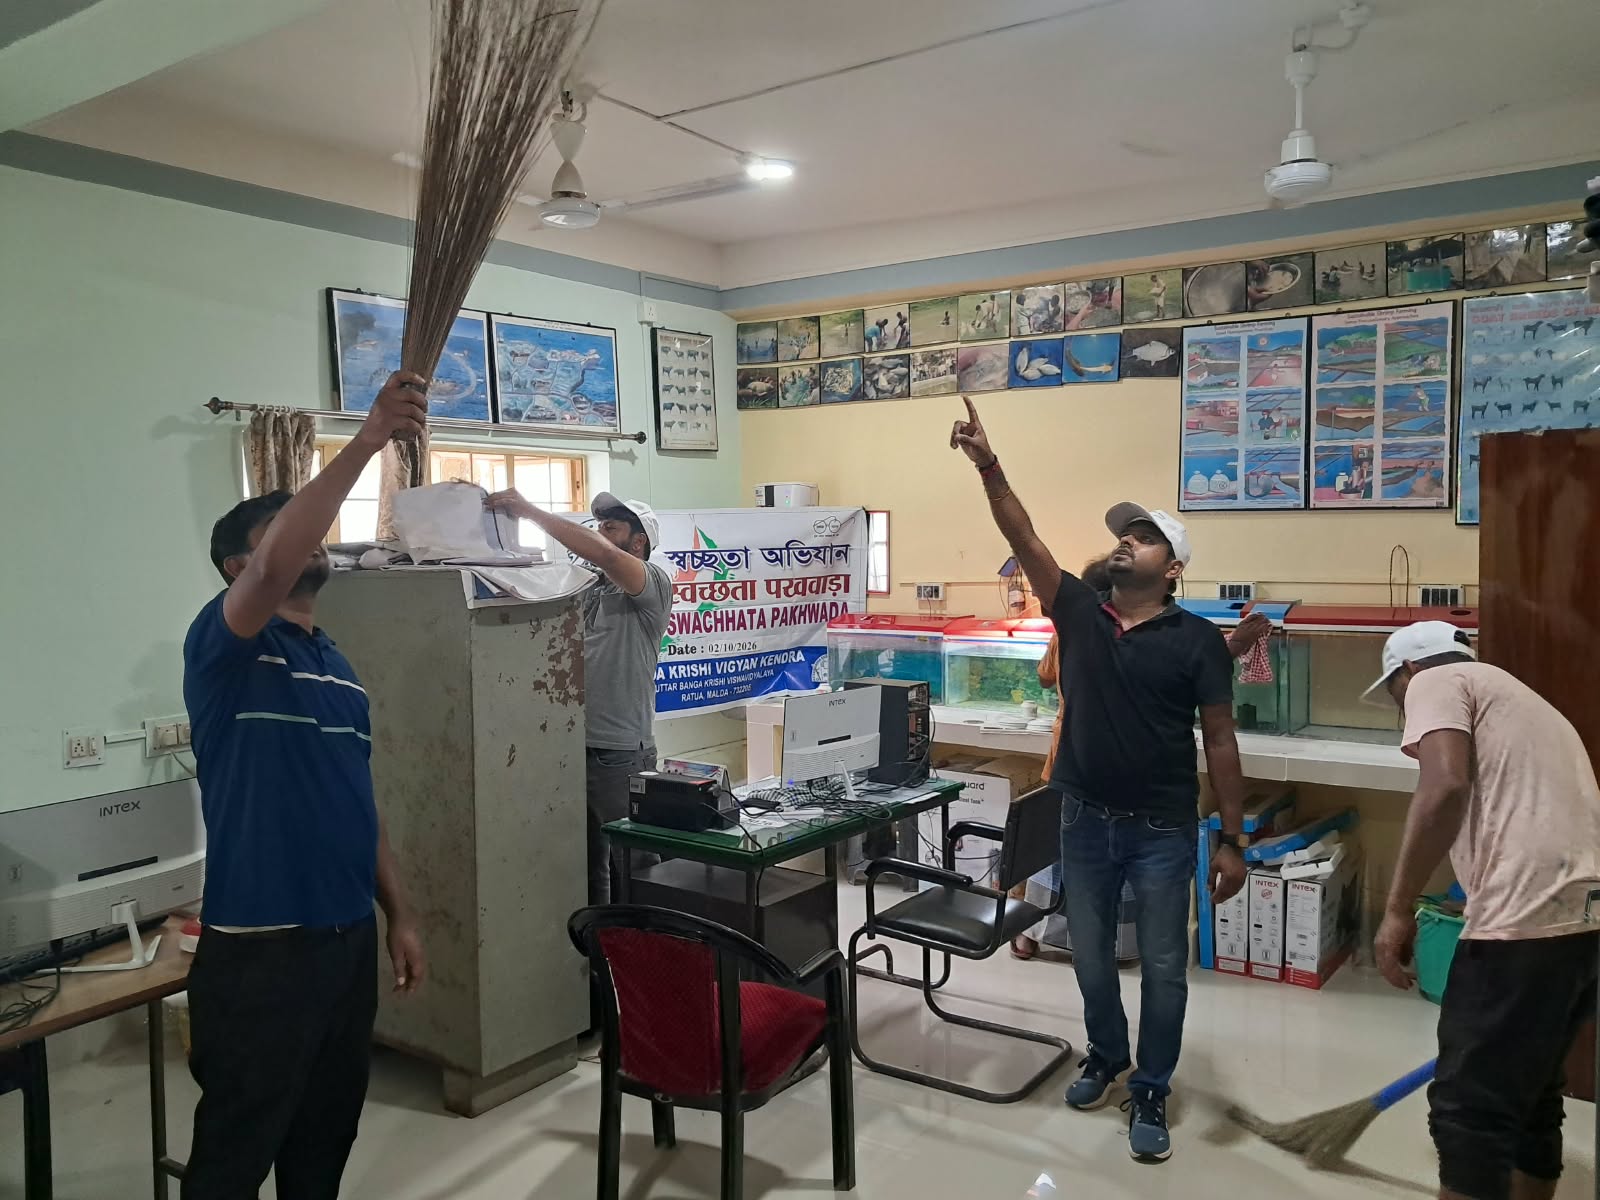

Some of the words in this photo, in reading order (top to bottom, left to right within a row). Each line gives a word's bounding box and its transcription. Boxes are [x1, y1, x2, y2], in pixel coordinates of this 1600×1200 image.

[759, 539, 851, 567] অভিযান
[667, 608, 767, 635] SWACHHATA
[667, 643, 697, 655] Date
[708, 641, 757, 653] 02/10/2026
[669, 663, 712, 680] KRISHI
[716, 657, 758, 674] VIGYAN
[760, 650, 805, 667] KENDRA
[655, 682, 678, 693] UTTAR
[680, 680, 703, 690] BANGA
[704, 678, 726, 687] KRISHI
[707, 689, 729, 699] MALDA
